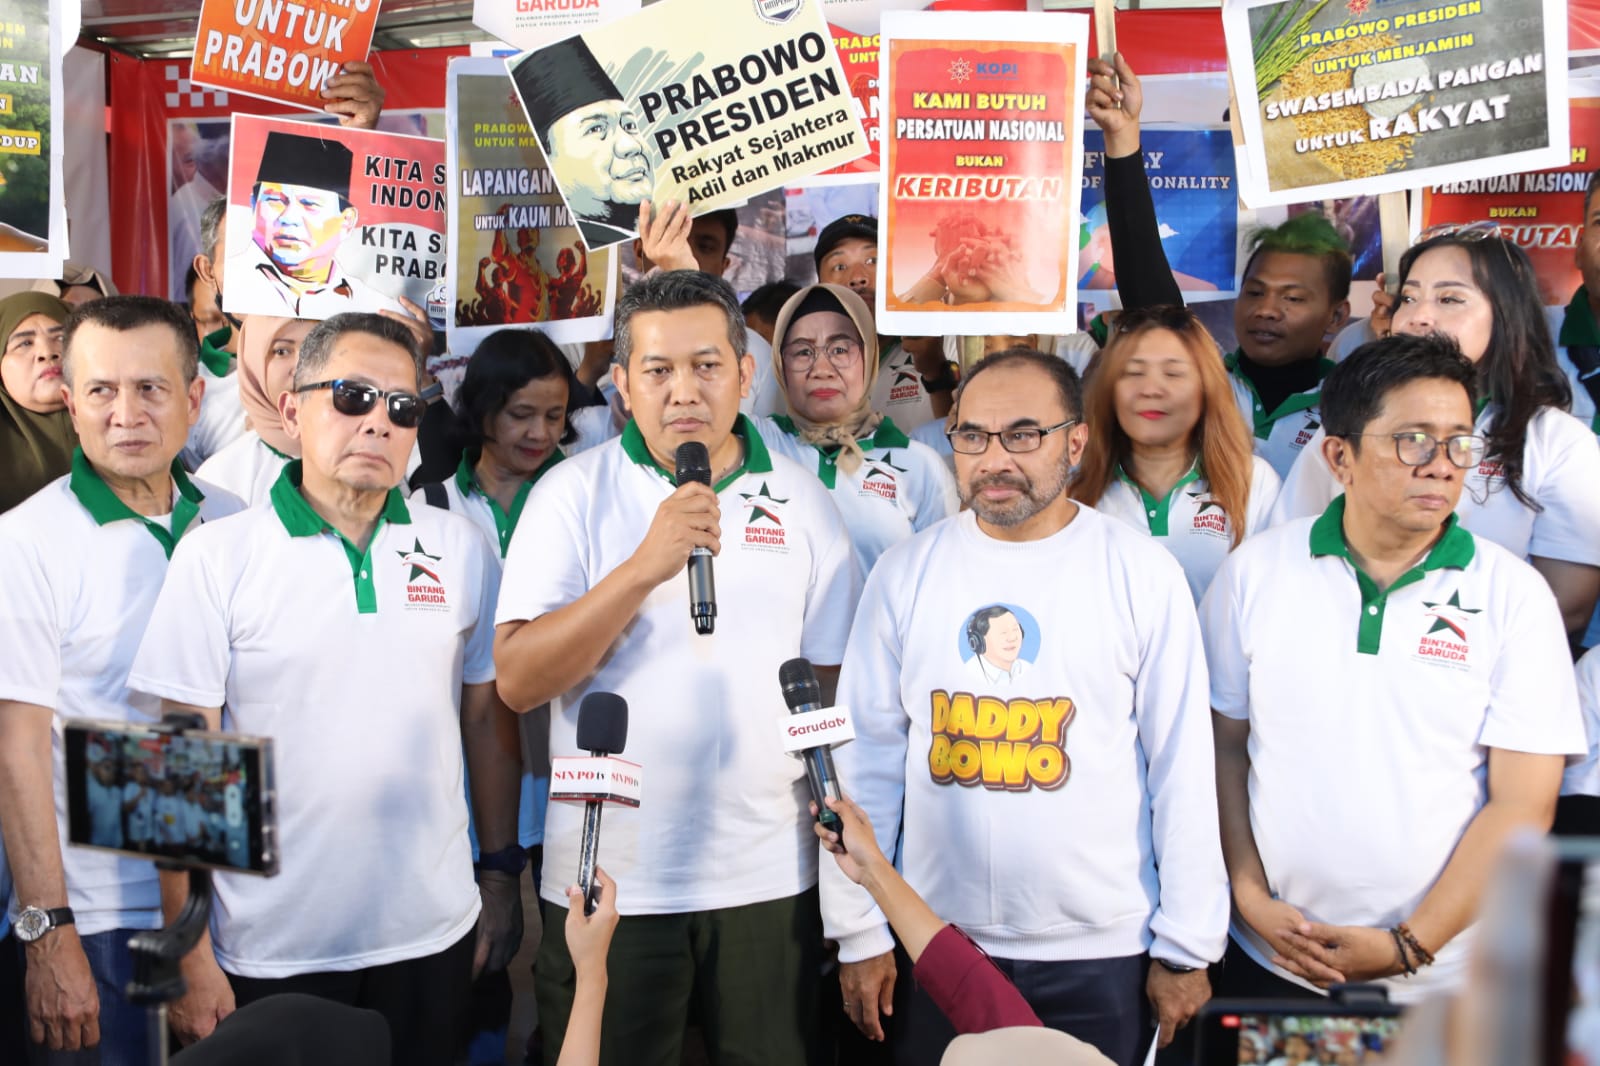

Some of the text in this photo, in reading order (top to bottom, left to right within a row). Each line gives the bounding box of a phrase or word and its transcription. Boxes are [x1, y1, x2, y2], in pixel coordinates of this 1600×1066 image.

[235, 0, 348, 52] UNTUK
[1299, 0, 1482, 47] PRABOWO PRESIDEN
[203, 29, 346, 91] PRABOW
[1313, 34, 1474, 75] UNTUK MENJAMIN
[639, 31, 826, 123] PRABOWO
[976, 63, 1018, 75] KOPI
[1265, 53, 1543, 120] SWASEMBADA PANGAN
[655, 67, 841, 160] PRESIDEN
[913, 92, 1047, 111] KAMI BUTUH
[896, 118, 1065, 142] PERSATUAN NASIONAL
[1295, 95, 1512, 153] UNTUK RAKYAT
[474, 137, 515, 147] UNTUK
[672, 109, 849, 184] Rakyat Sejahtera
[365, 156, 423, 182] KITA
[688, 131, 855, 204] Adil dan Makmur
[955, 156, 1004, 167] BUKAN
[461, 168, 553, 196] LAPANGAN
[895, 174, 1063, 200] KERIBUTAN
[474, 214, 506, 230] UNTUK
[508, 205, 551, 229] KAUM
[1489, 206, 1537, 218] BUKAN
[361, 226, 417, 251] KITA
[744, 527, 786, 537] BINTANG
[1193, 521, 1225, 532] GARUDA
[745, 535, 786, 545] GARUDA
[406, 585, 446, 595] BINTANG
[408, 594, 446, 604] GARUDA
[1418, 646, 1468, 662] GARUDA
[1420, 637, 1469, 653] BINTANG
[787, 717, 847, 737] Garudatv
[931, 689, 1076, 745] DADDY
[929, 733, 1071, 792] BOWO
